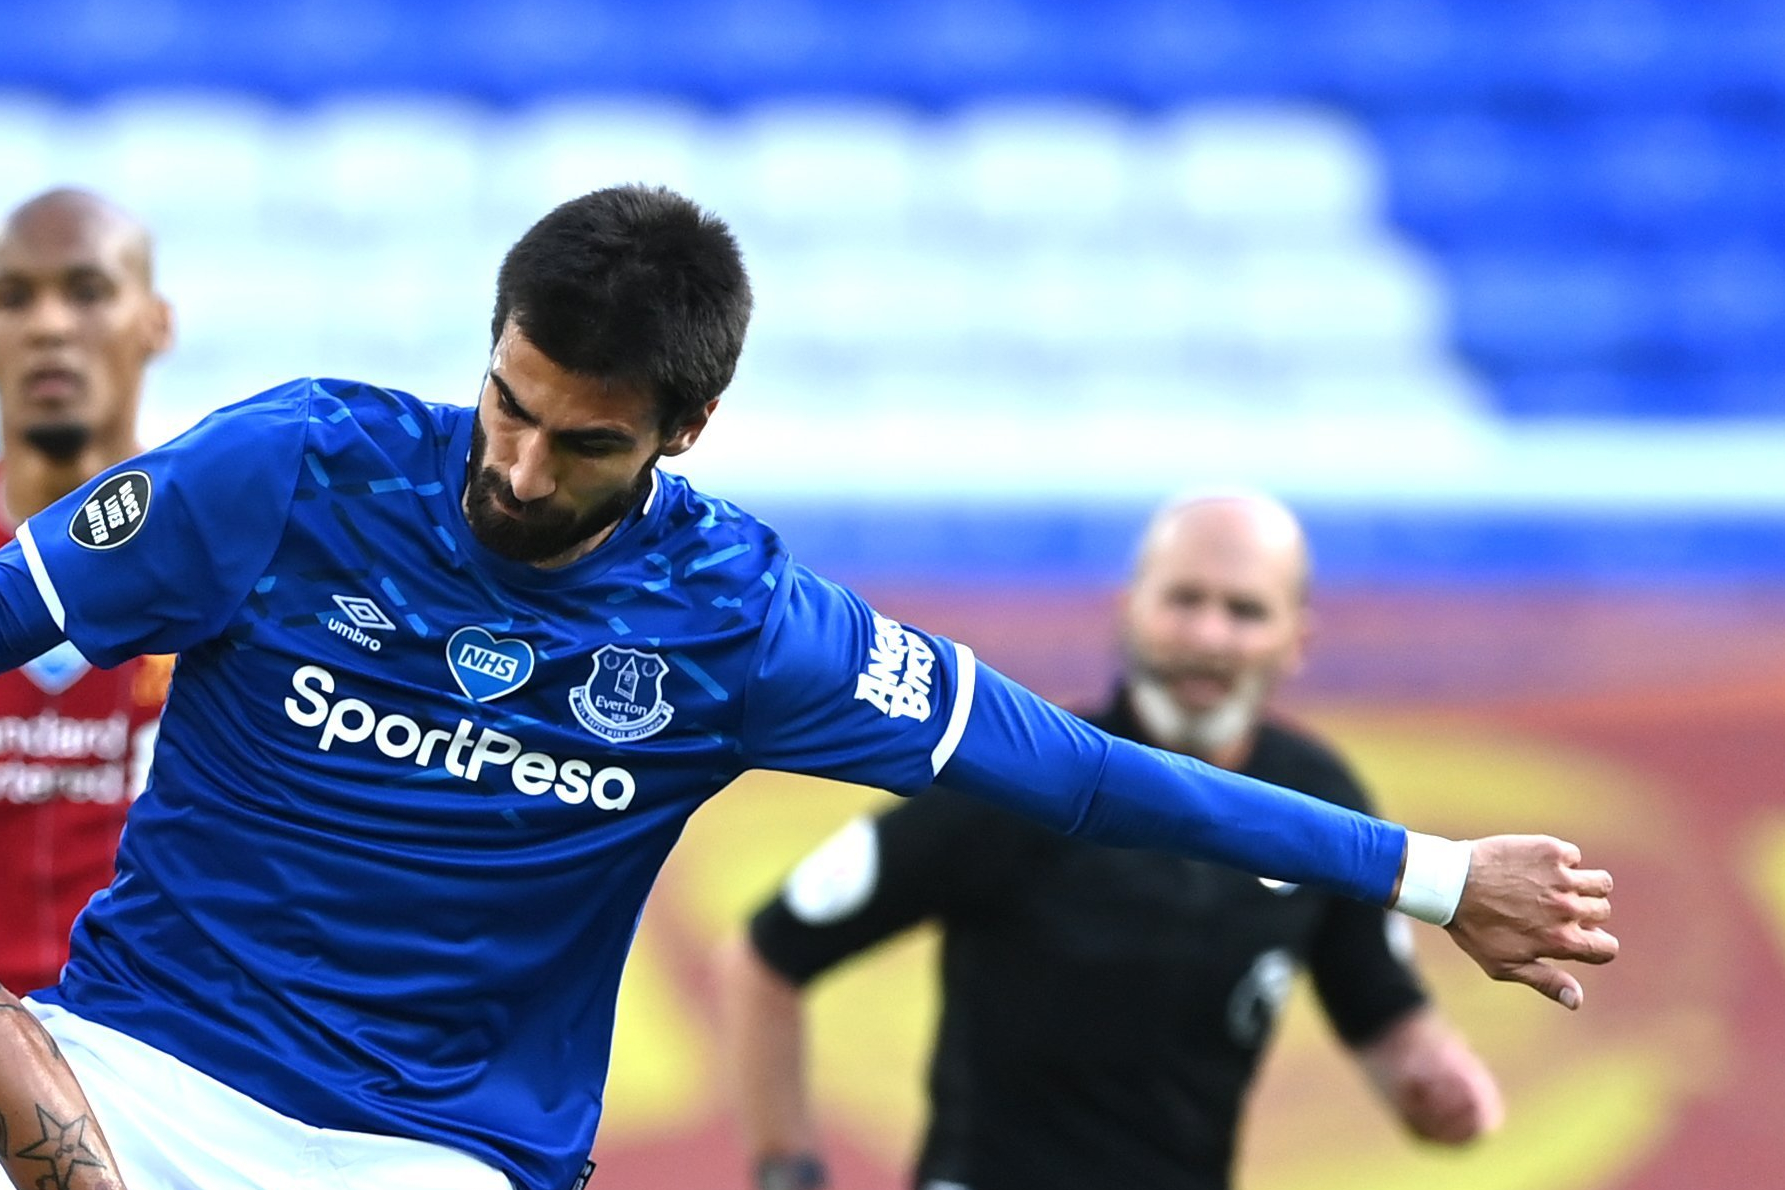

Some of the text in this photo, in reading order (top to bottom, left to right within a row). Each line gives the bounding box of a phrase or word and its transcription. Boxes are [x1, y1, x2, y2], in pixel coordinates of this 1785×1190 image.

[103, 494, 125, 529] LIVES
[328, 617, 381, 652] umbro
[461, 646, 516, 677] NHS
[853, 609, 909, 715] ANGR
[595, 694, 648, 716] Everton
[284, 664, 636, 811] SportPesa
